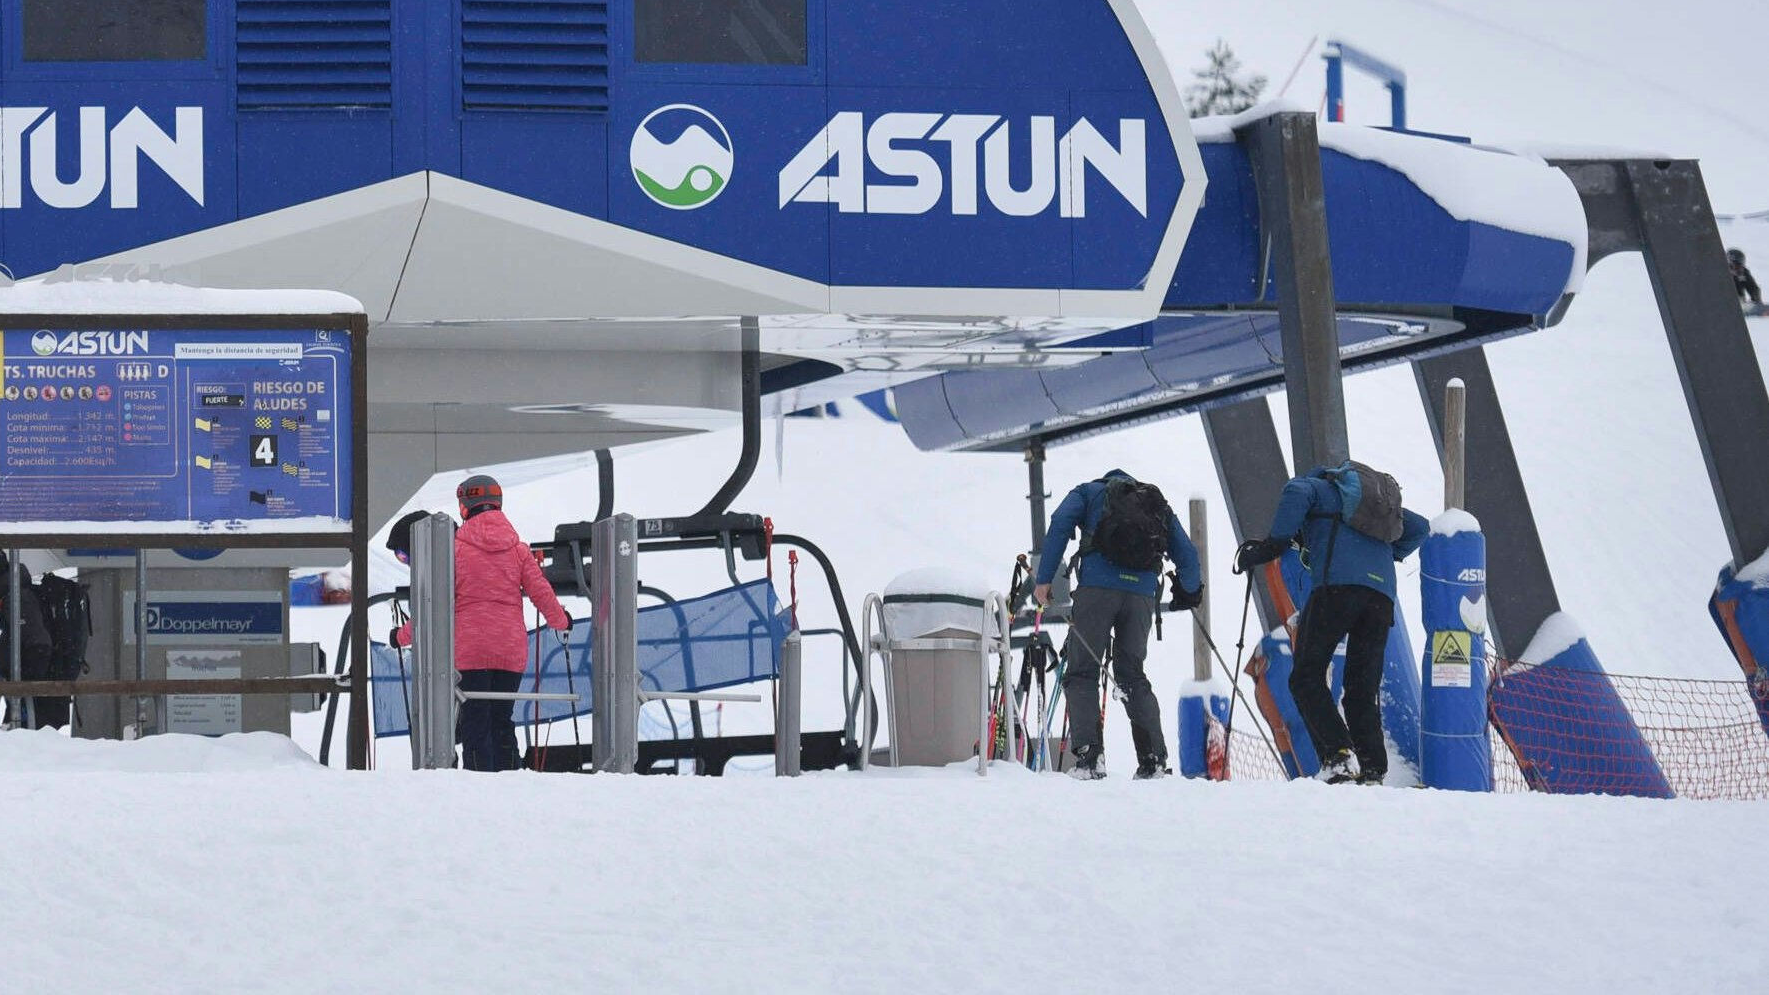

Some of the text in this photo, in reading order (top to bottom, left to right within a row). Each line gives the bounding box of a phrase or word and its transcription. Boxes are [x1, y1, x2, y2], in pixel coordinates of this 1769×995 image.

[779, 111, 1147, 219] ASTUN
[57, 330, 148, 355] ASTUN
[180, 346, 299, 355] Mantenga la distancia de seguridad
[27, 365, 96, 378] TRUCHAS
[158, 365, 169, 378] D
[253, 381, 325, 394] RIESGO DE
[124, 390, 157, 400] PISTAS
[205, 396, 228, 405] FUERTE
[253, 398, 307, 411] ALUDES
[7, 423, 28, 432] Cota
[7, 434, 28, 443] Cota
[255, 437, 274, 464] 4
[161, 615, 253, 635] Doppelmayr
